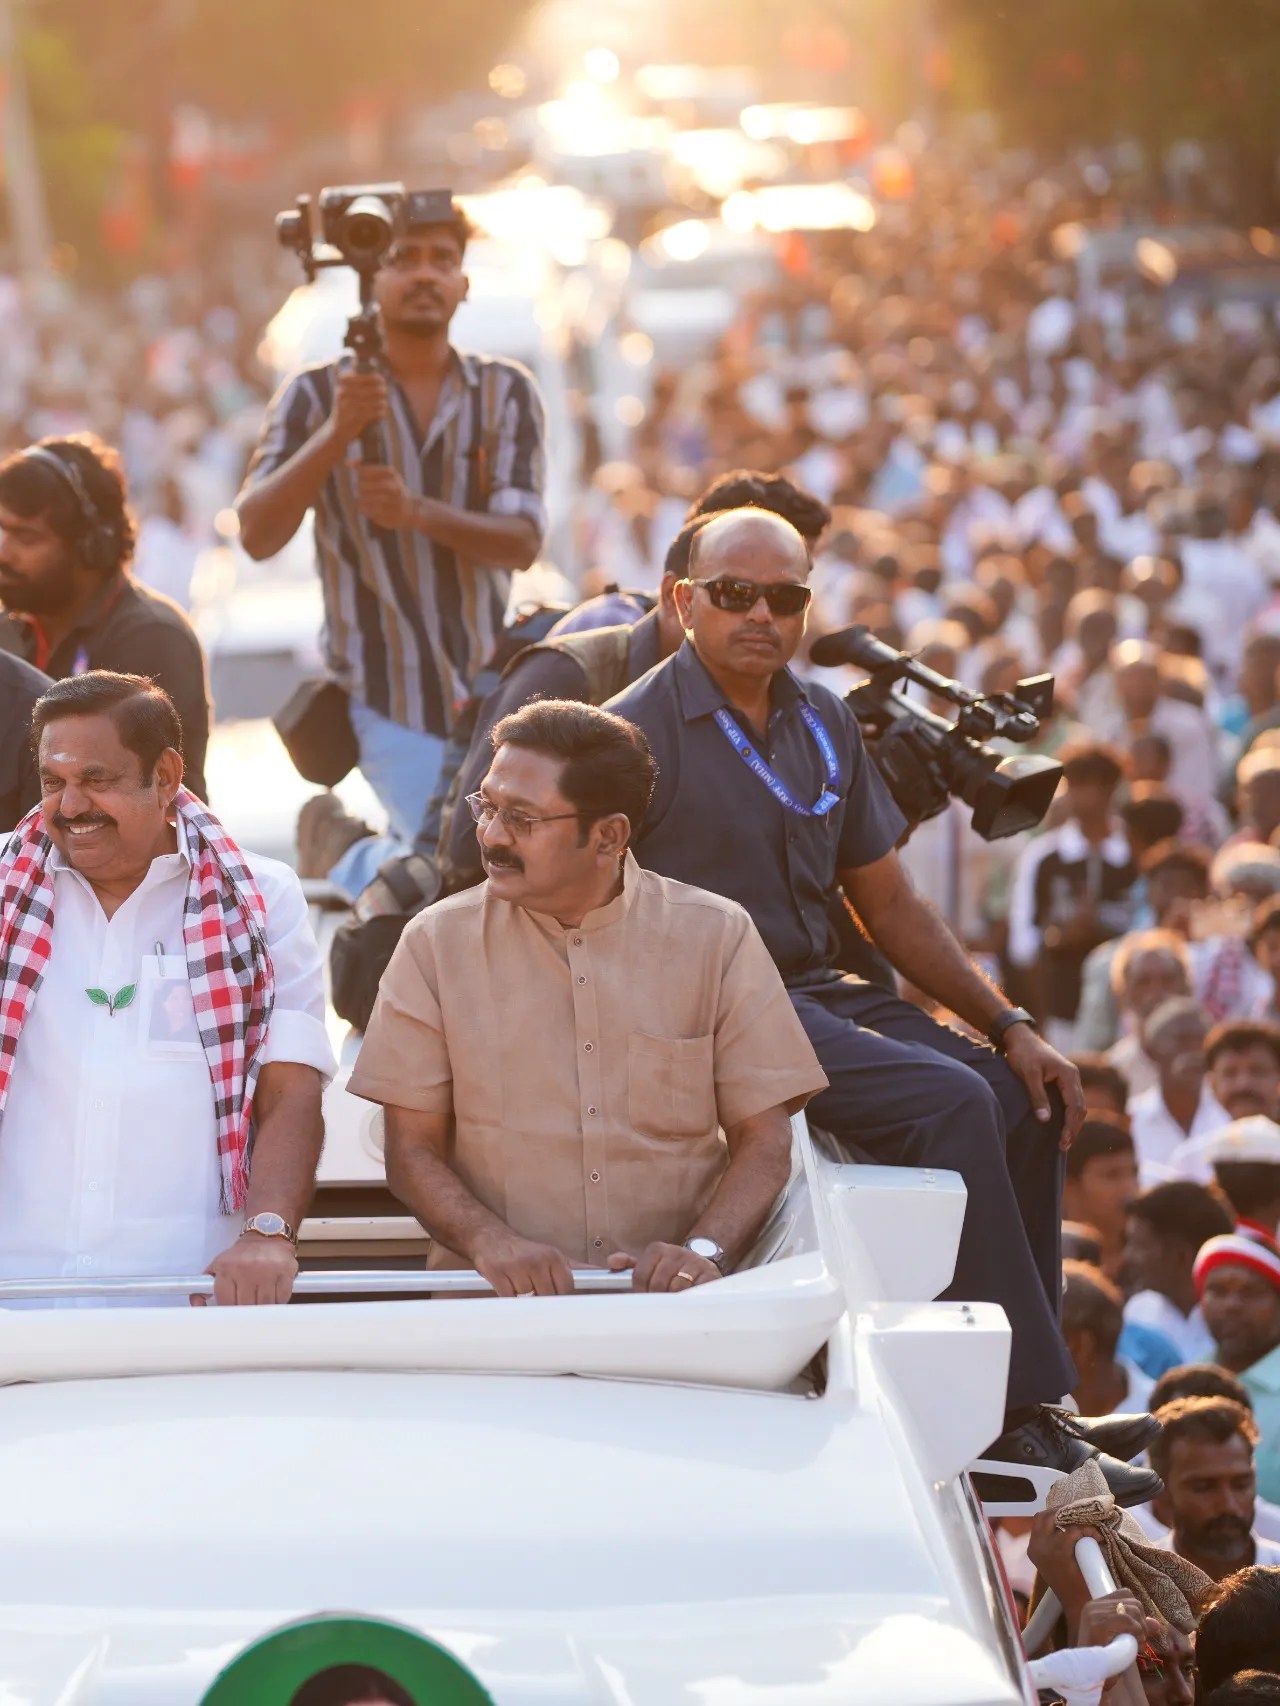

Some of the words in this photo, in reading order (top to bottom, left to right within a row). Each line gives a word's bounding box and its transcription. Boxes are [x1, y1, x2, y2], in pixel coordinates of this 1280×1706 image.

[717, 709, 732, 729] Secu
[728, 728, 741, 745] VIP
[772, 786, 793, 807] CRPF
